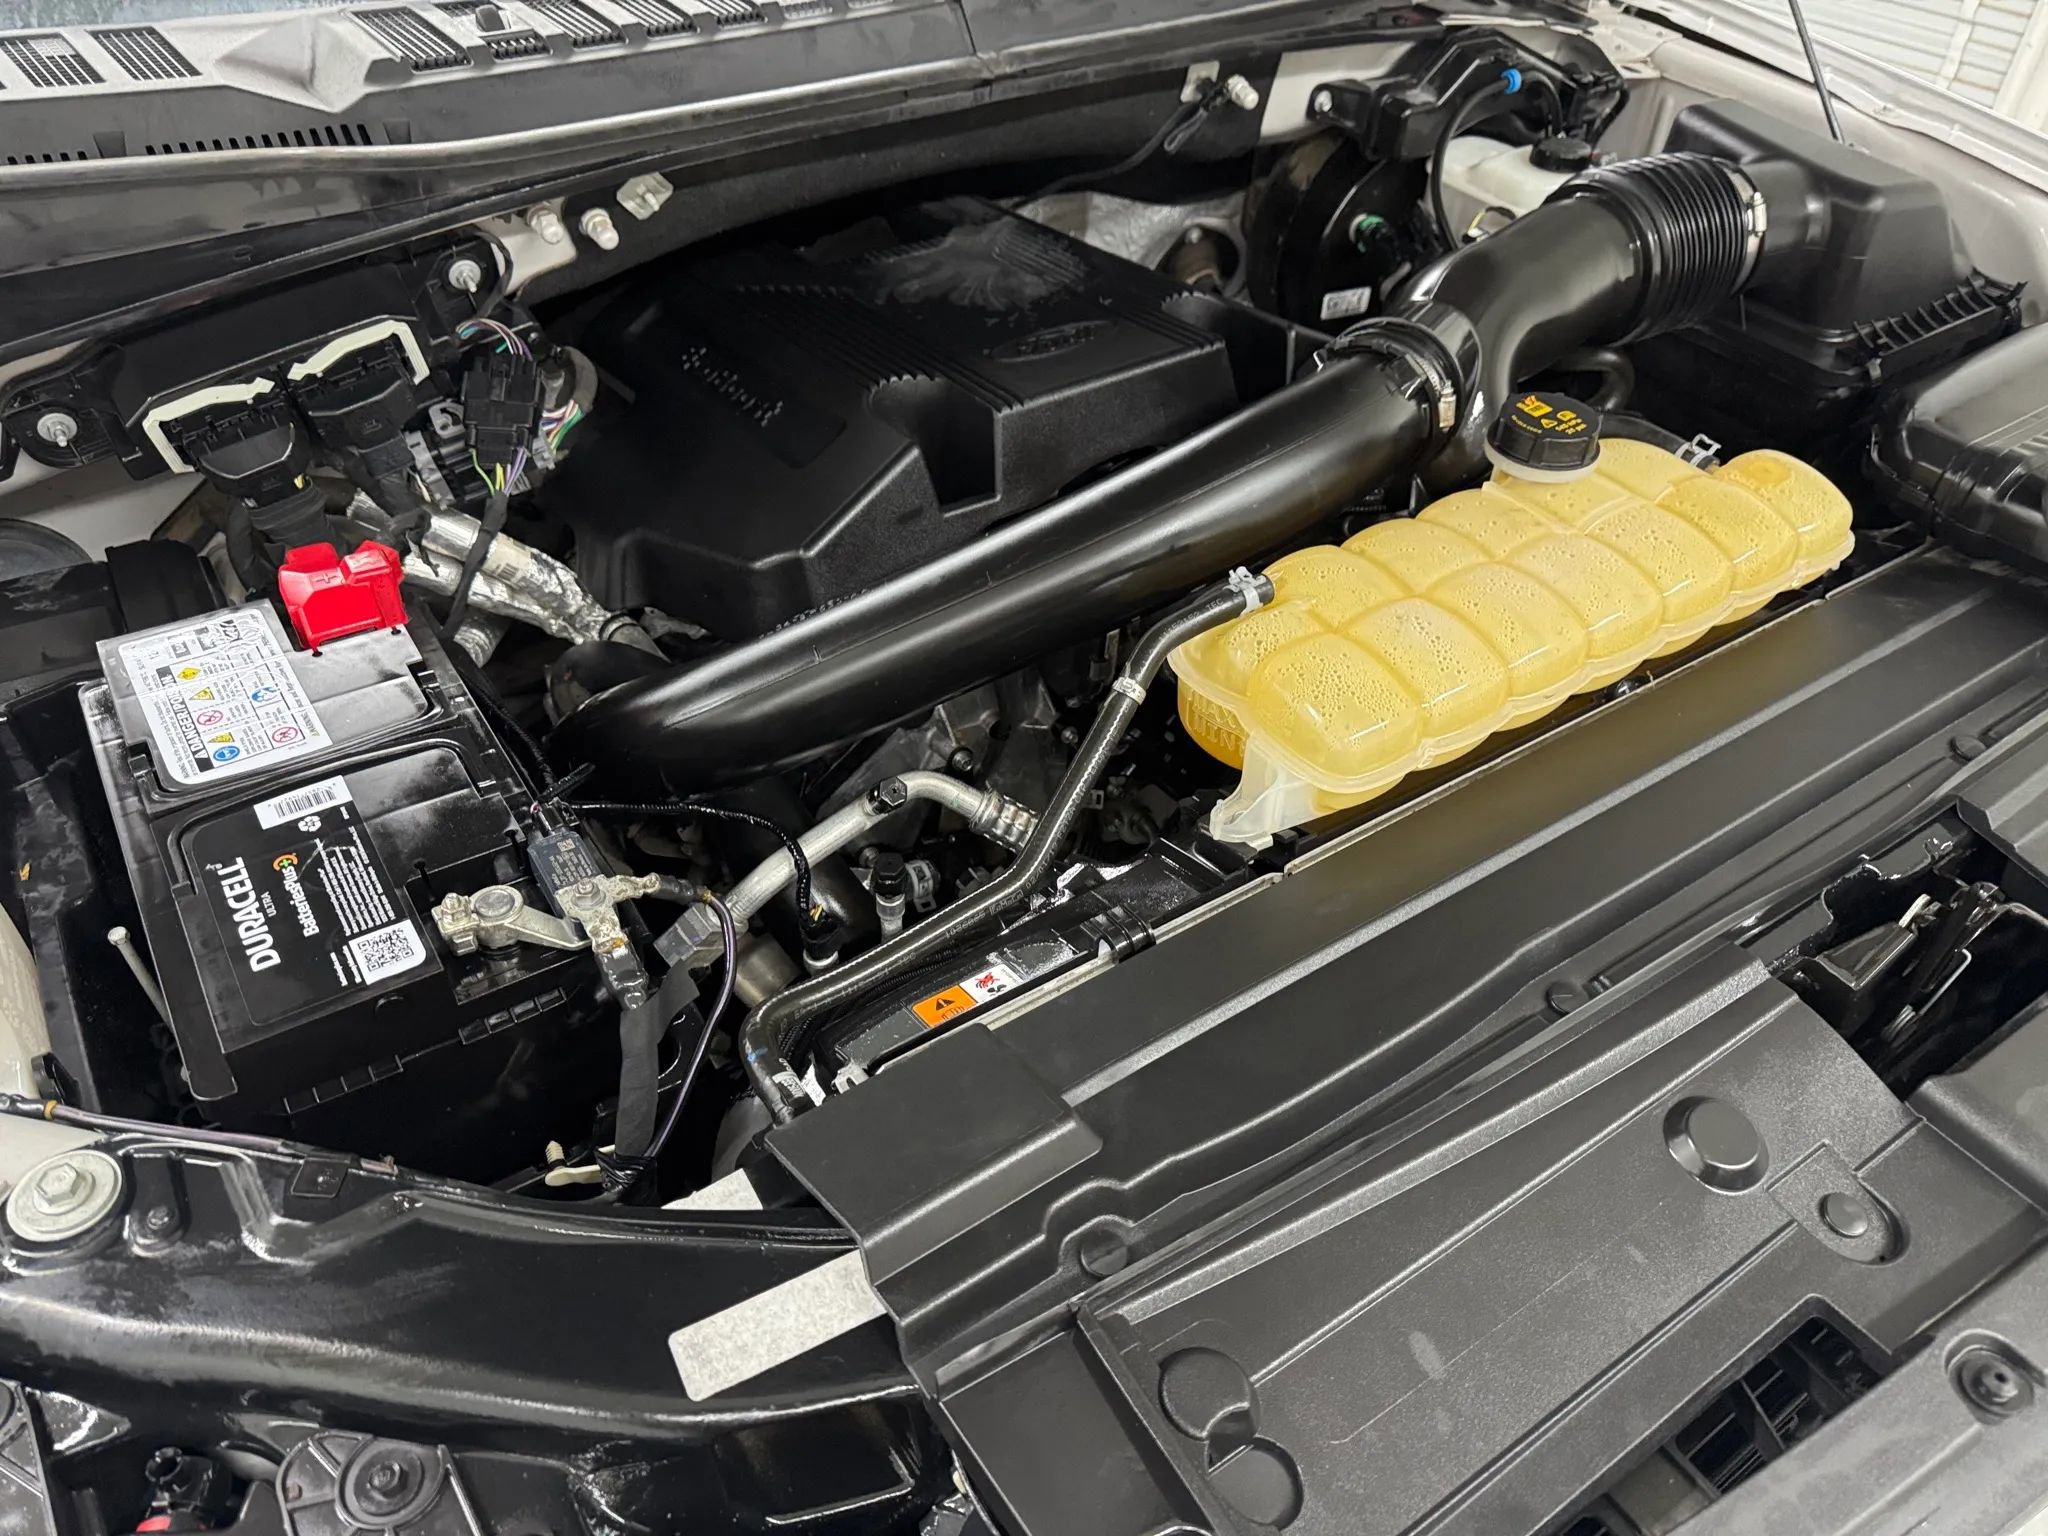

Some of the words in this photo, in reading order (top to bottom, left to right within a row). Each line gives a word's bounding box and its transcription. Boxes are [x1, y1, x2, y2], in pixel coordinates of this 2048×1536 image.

[1192, 690, 1237, 729] MAX
[1194, 711, 1236, 752] MIN
[217, 856, 281, 972] DURACELL
[260, 891, 277, 917] ULTRA
